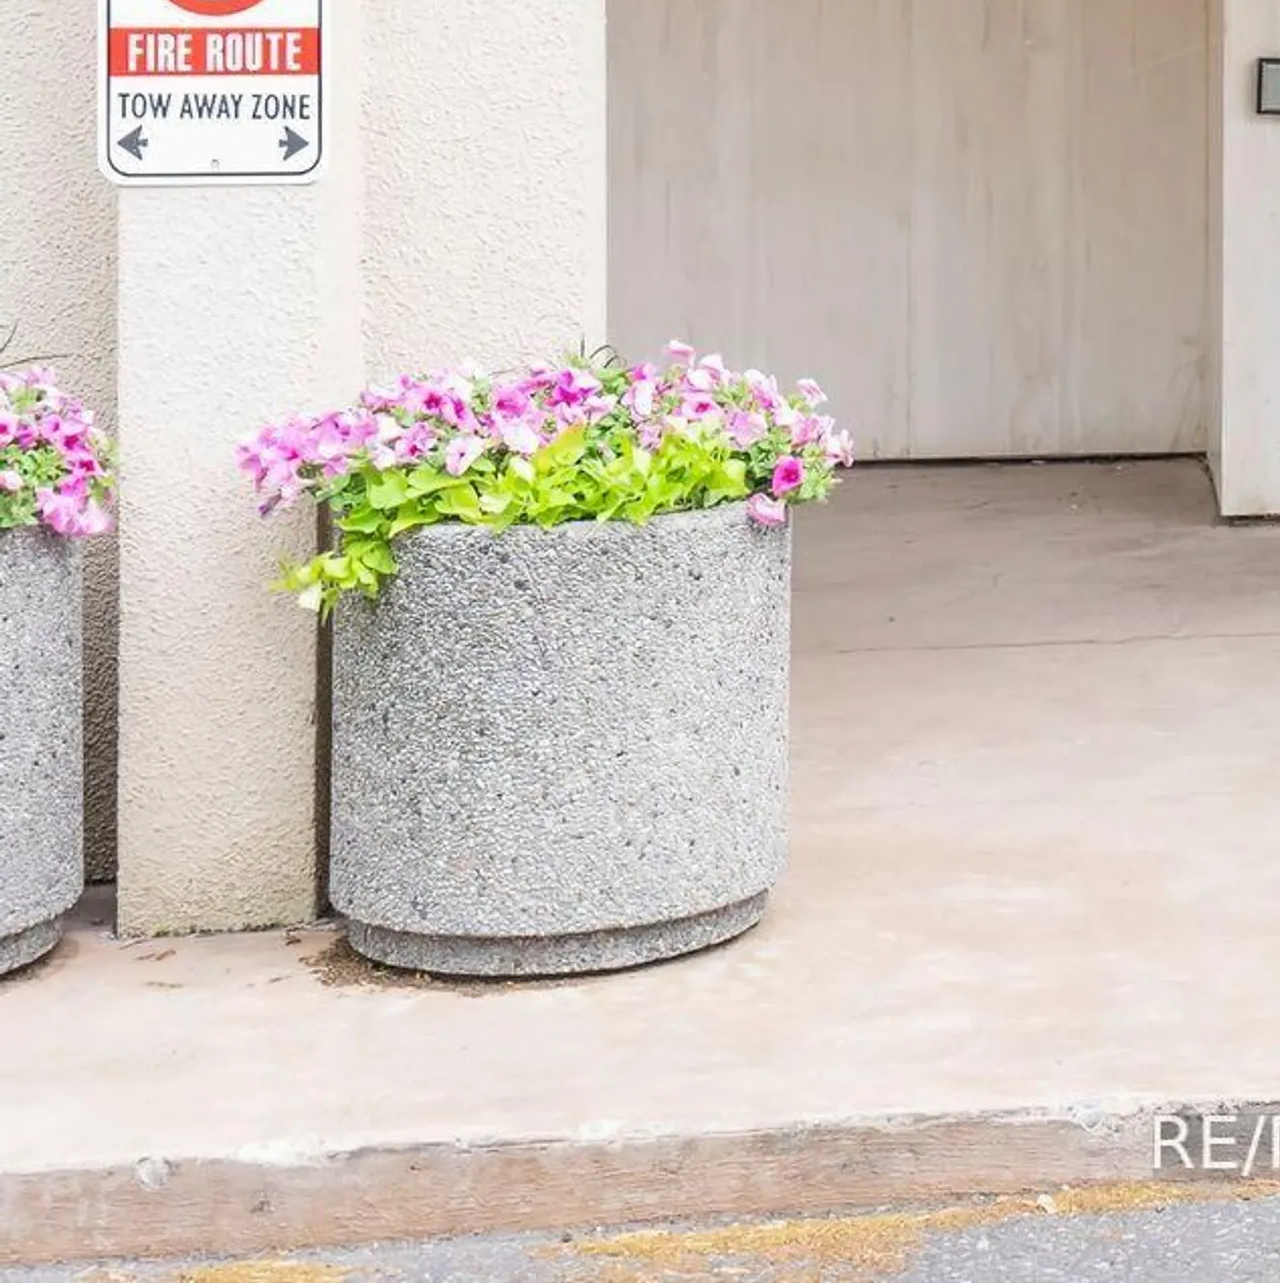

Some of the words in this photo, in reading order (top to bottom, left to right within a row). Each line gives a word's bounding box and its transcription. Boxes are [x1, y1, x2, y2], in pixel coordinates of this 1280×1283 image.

[128, 33, 193, 72] FIRE
[206, 32, 302, 72] ROUTE
[118, 93, 171, 119] TOW
[180, 94, 243, 119] AWAY
[252, 94, 310, 120] ZONE
